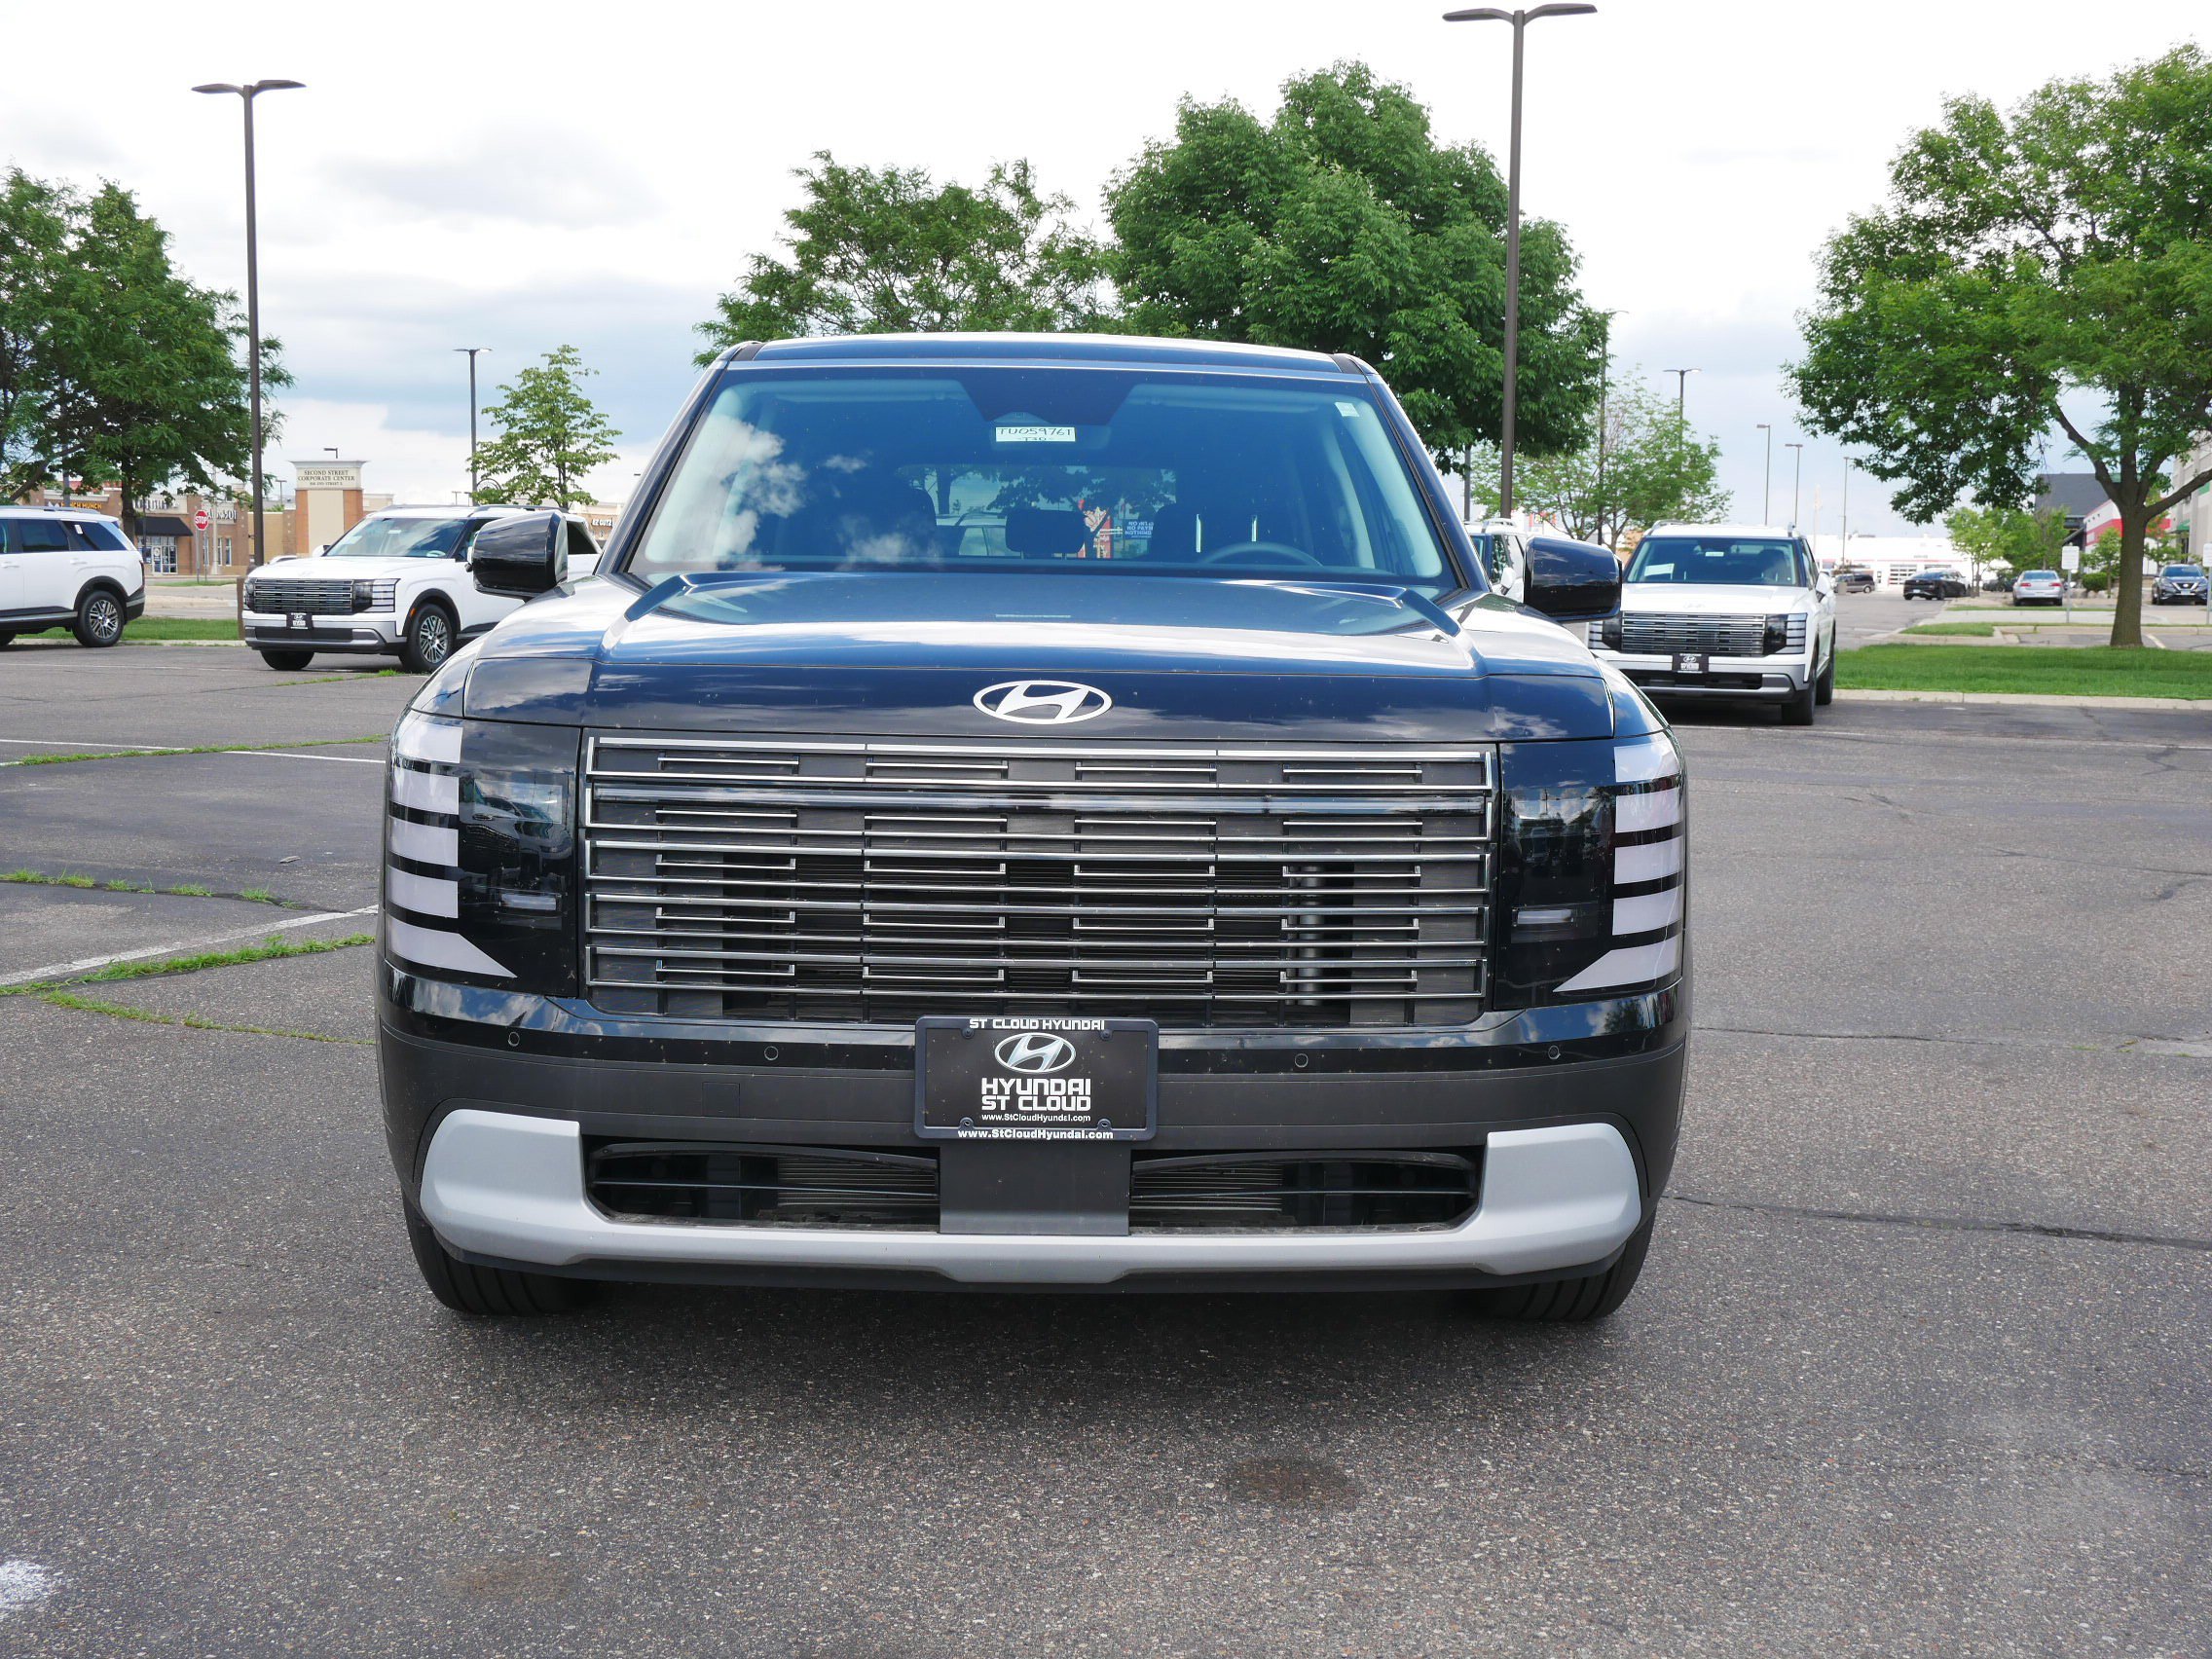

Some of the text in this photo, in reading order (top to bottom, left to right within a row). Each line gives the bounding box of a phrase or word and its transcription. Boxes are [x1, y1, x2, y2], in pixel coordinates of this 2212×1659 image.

[195, 516, 207, 525] STOP
[969, 1018, 1105, 1030] ST CLOUD HYUNDAI
[981, 1078, 1090, 1095] HYUNDAI
[981, 1095, 1091, 1111] ST CLOUD
[981, 1113, 1091, 1123] www.StCloudHyundai.com
[957, 1128, 1114, 1140] www.StCloudHyundai.com
